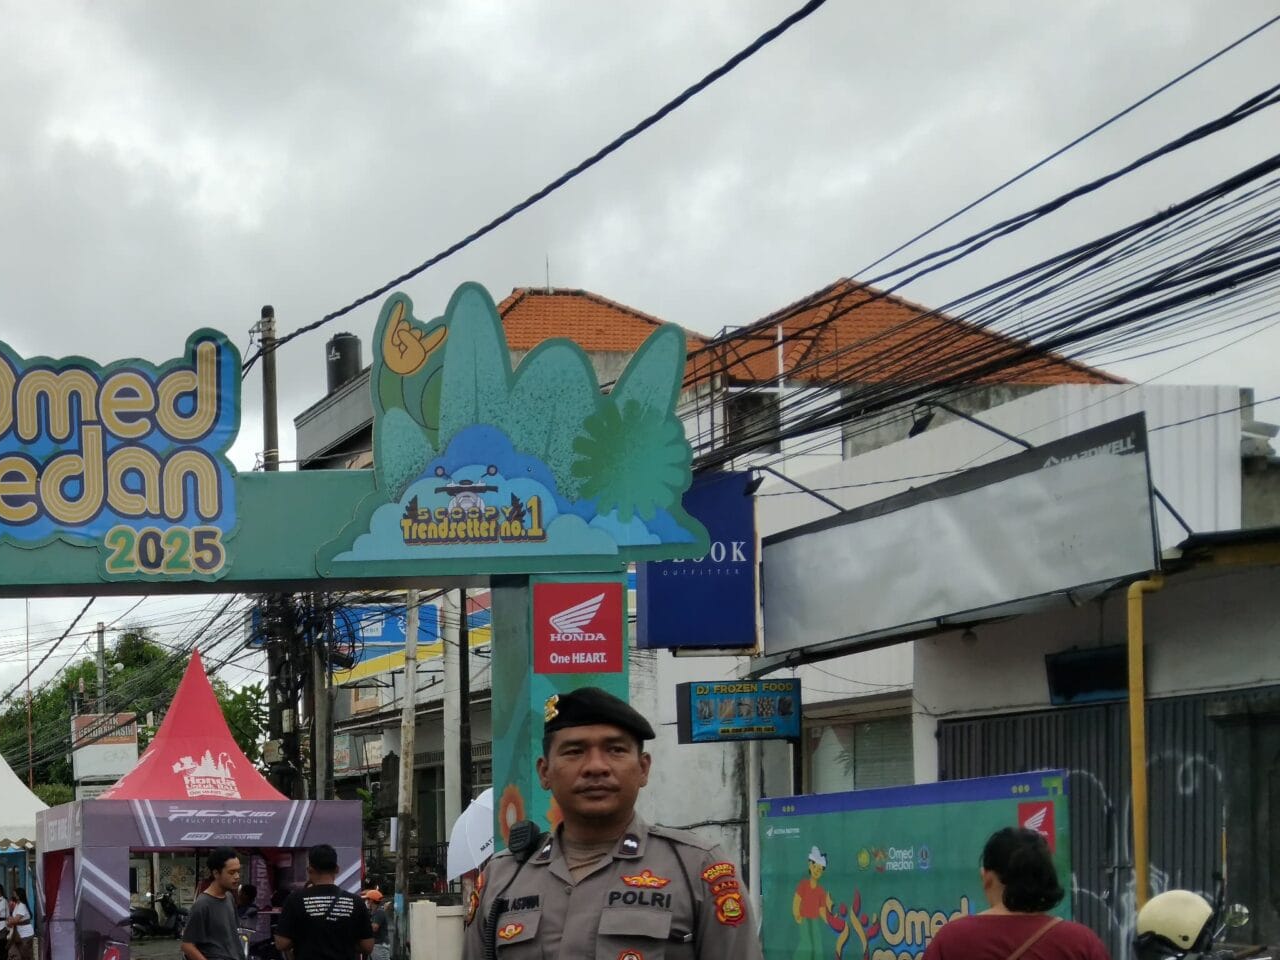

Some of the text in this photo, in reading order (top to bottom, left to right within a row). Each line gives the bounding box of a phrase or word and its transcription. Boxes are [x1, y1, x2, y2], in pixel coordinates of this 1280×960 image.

[417, 506, 514, 520] SCOOPY
[401, 517, 498, 541] Trendsetter
[106, 525, 225, 574] 2025
[550, 632, 607, 641] HONDA
[549, 652, 608, 664] One HEART.
[696, 682, 794, 695] DJ FROZEN FOOD
[888, 846, 914, 860] Omed
[886, 857, 914, 871] medan
[609, 891, 672, 908] POLRI
